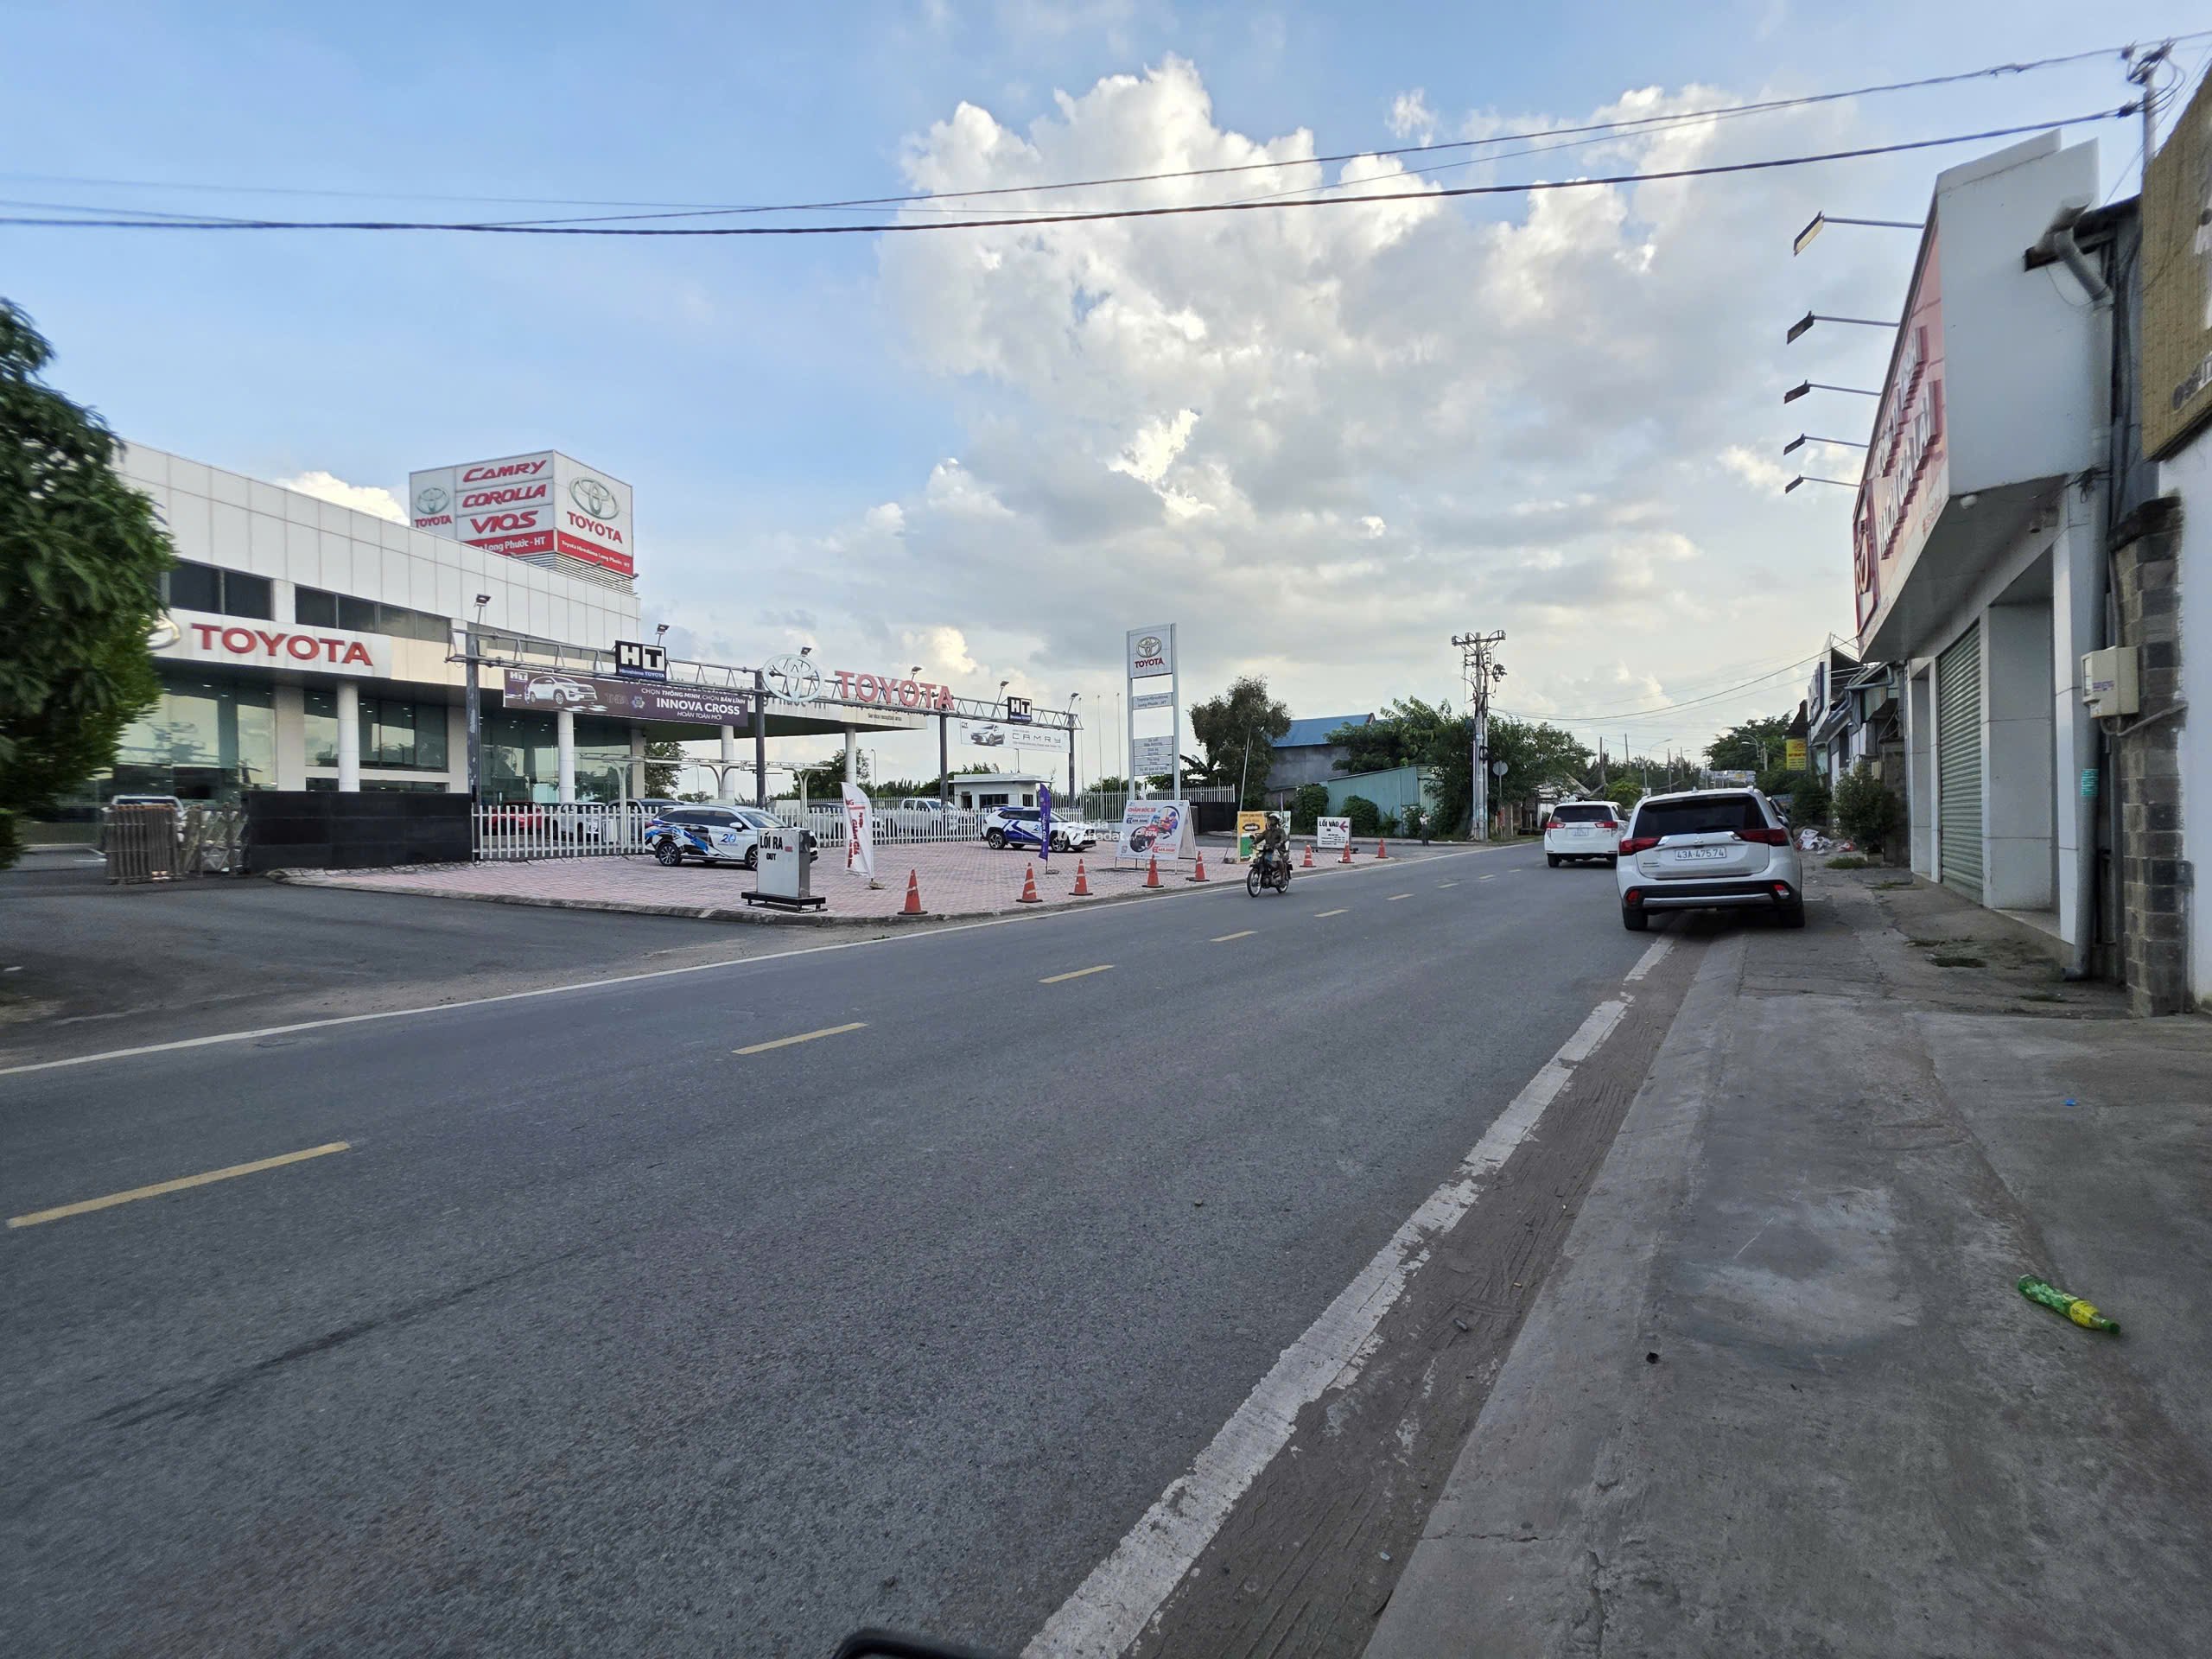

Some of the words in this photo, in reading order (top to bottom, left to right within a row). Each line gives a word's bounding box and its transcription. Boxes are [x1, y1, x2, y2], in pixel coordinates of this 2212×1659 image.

[463, 460, 546, 482] CAMRY
[462, 484, 546, 508] COROLLA
[415, 515, 452, 528] TOYOTA
[470, 510, 538, 534] VIOS
[567, 511, 622, 543] TOYOTA
[534, 536, 545, 546] HT
[191, 623, 373, 666] TOYOTA
[620, 645, 664, 671] HT
[1135, 658, 1165, 669] TOYOTA
[510, 671, 528, 681] HT
[834, 671, 955, 710] TOYOTA
[657, 698, 702, 711] INNOVA
[705, 702, 740, 715] CROSS
[1011, 700, 1031, 715] HT
[1012, 733, 1061, 744] CAMRY
[760, 831, 772, 849] LỐI
[773, 836, 783, 850] RA
[766, 852, 776, 861] OUT
